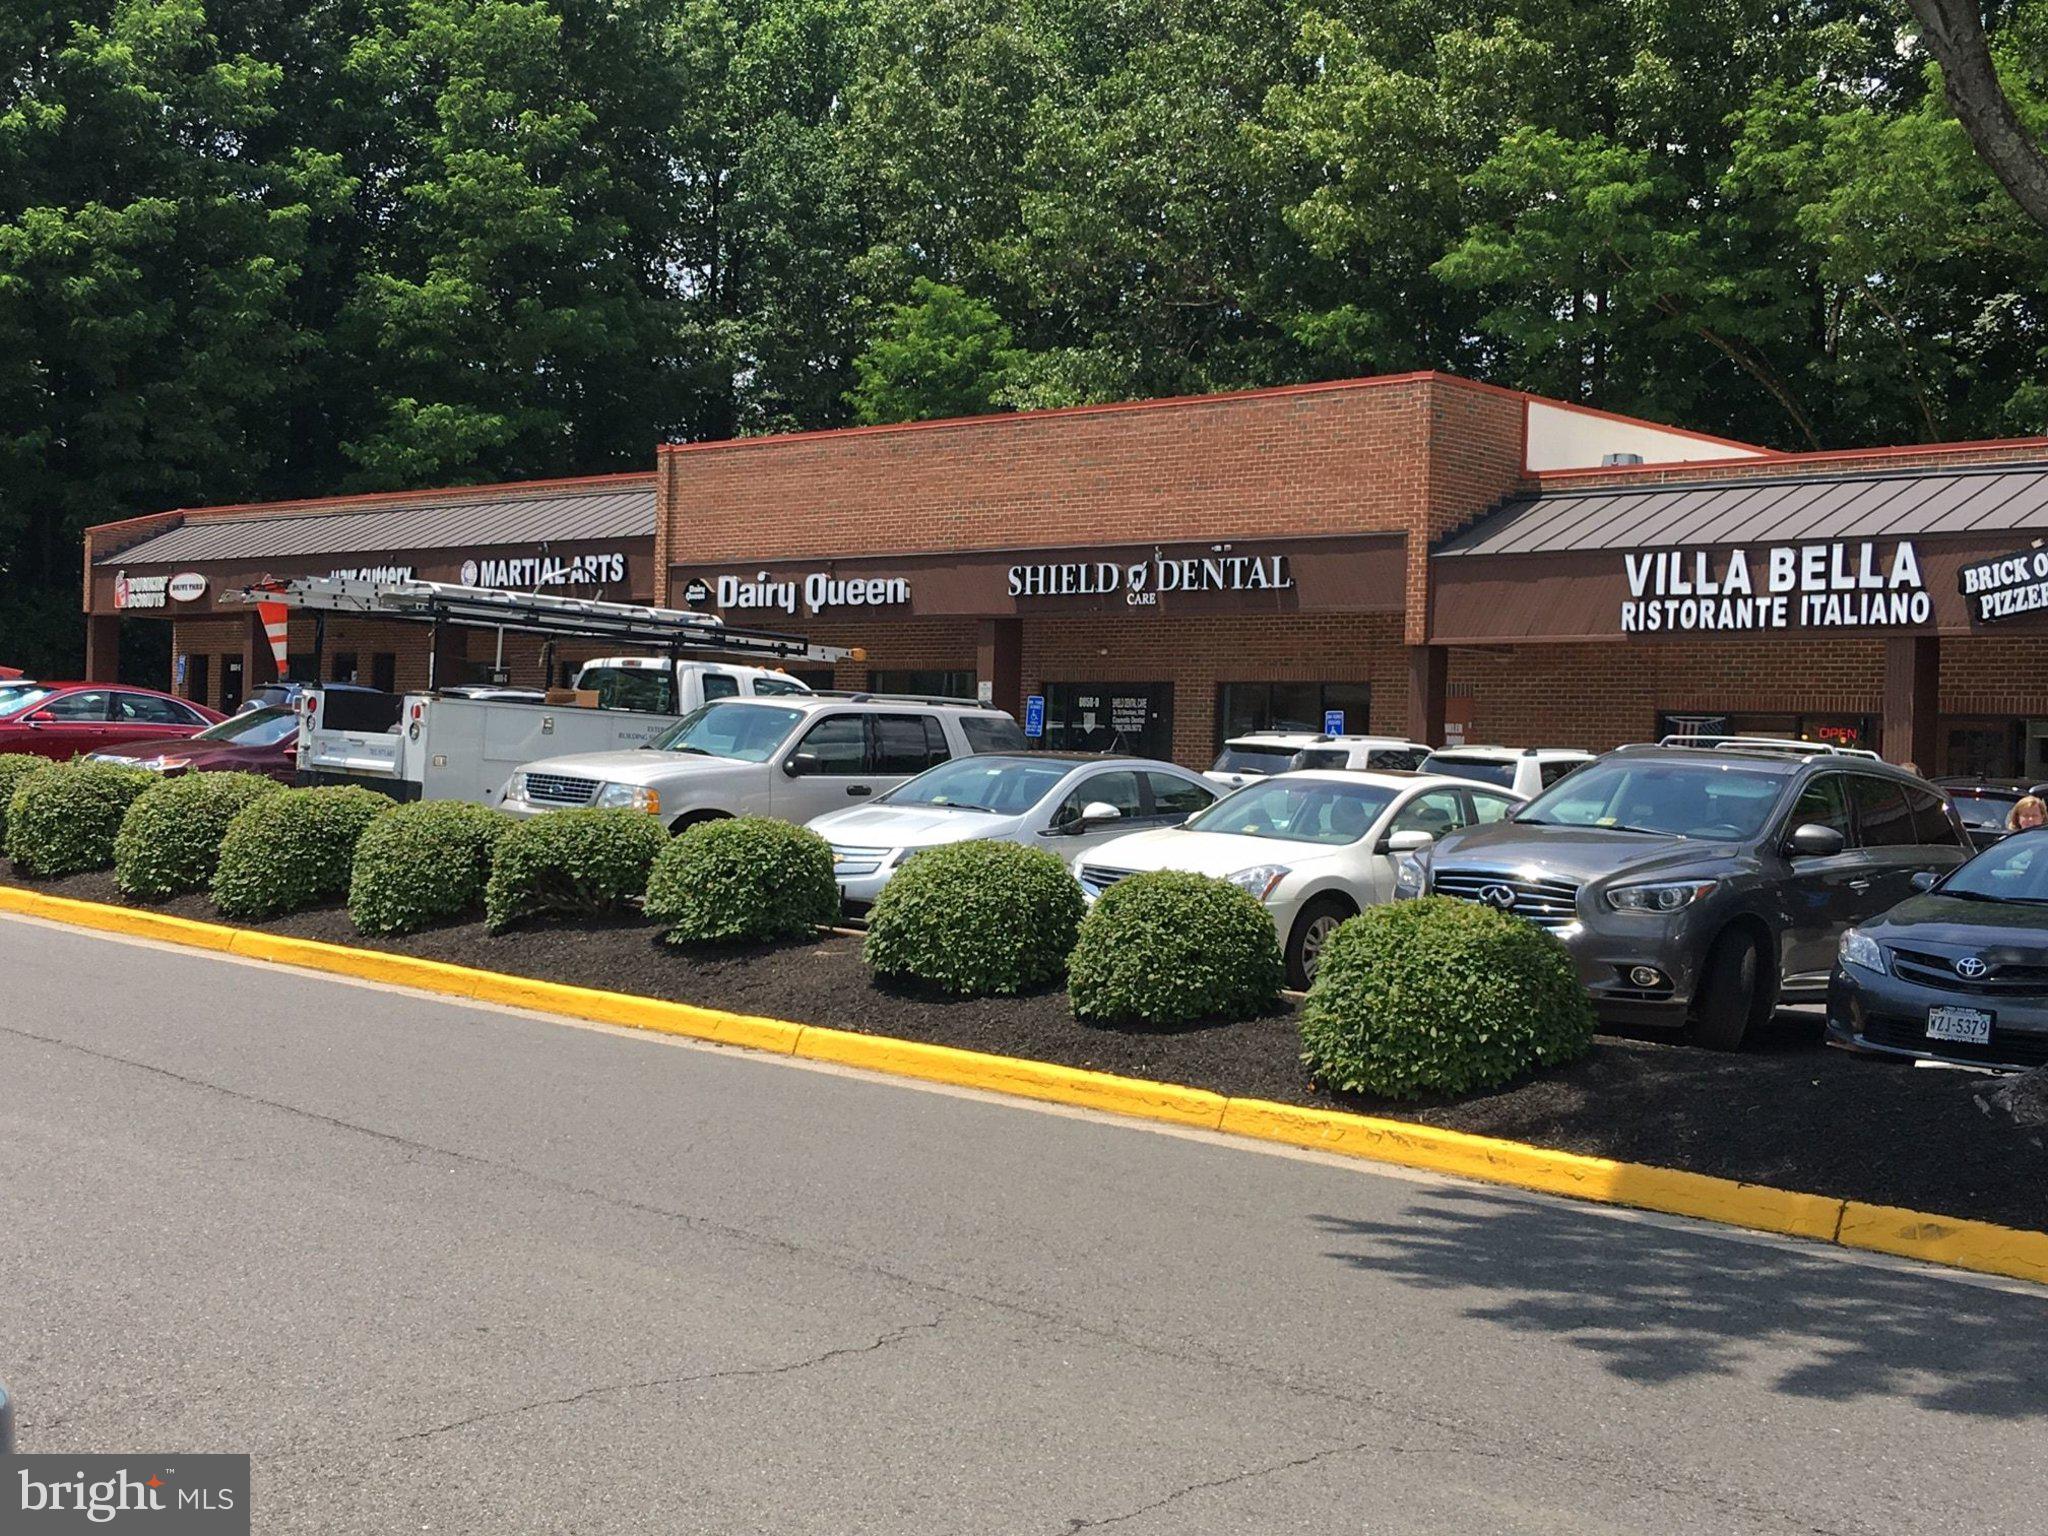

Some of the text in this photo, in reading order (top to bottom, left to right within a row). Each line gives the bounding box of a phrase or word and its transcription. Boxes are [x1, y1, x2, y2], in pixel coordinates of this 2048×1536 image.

[480, 557, 565, 587] MARTIAL
[570, 553, 625, 584] ARTS
[1008, 555, 1292, 597] SHIELD DENTAL
[1624, 542, 1922, 597] VILLA BELLA
[1963, 557, 2031, 594] BRICK
[128, 592, 166, 608] DONUTS
[717, 571, 907, 614] Dairy Queen
[1126, 592, 1157, 606] CARE
[1621, 590, 1931, 631] RISTORANTE ITALIANO
[1819, 727, 1857, 740] OPEN
[1930, 1014, 1988, 1036] WZJ-5379
